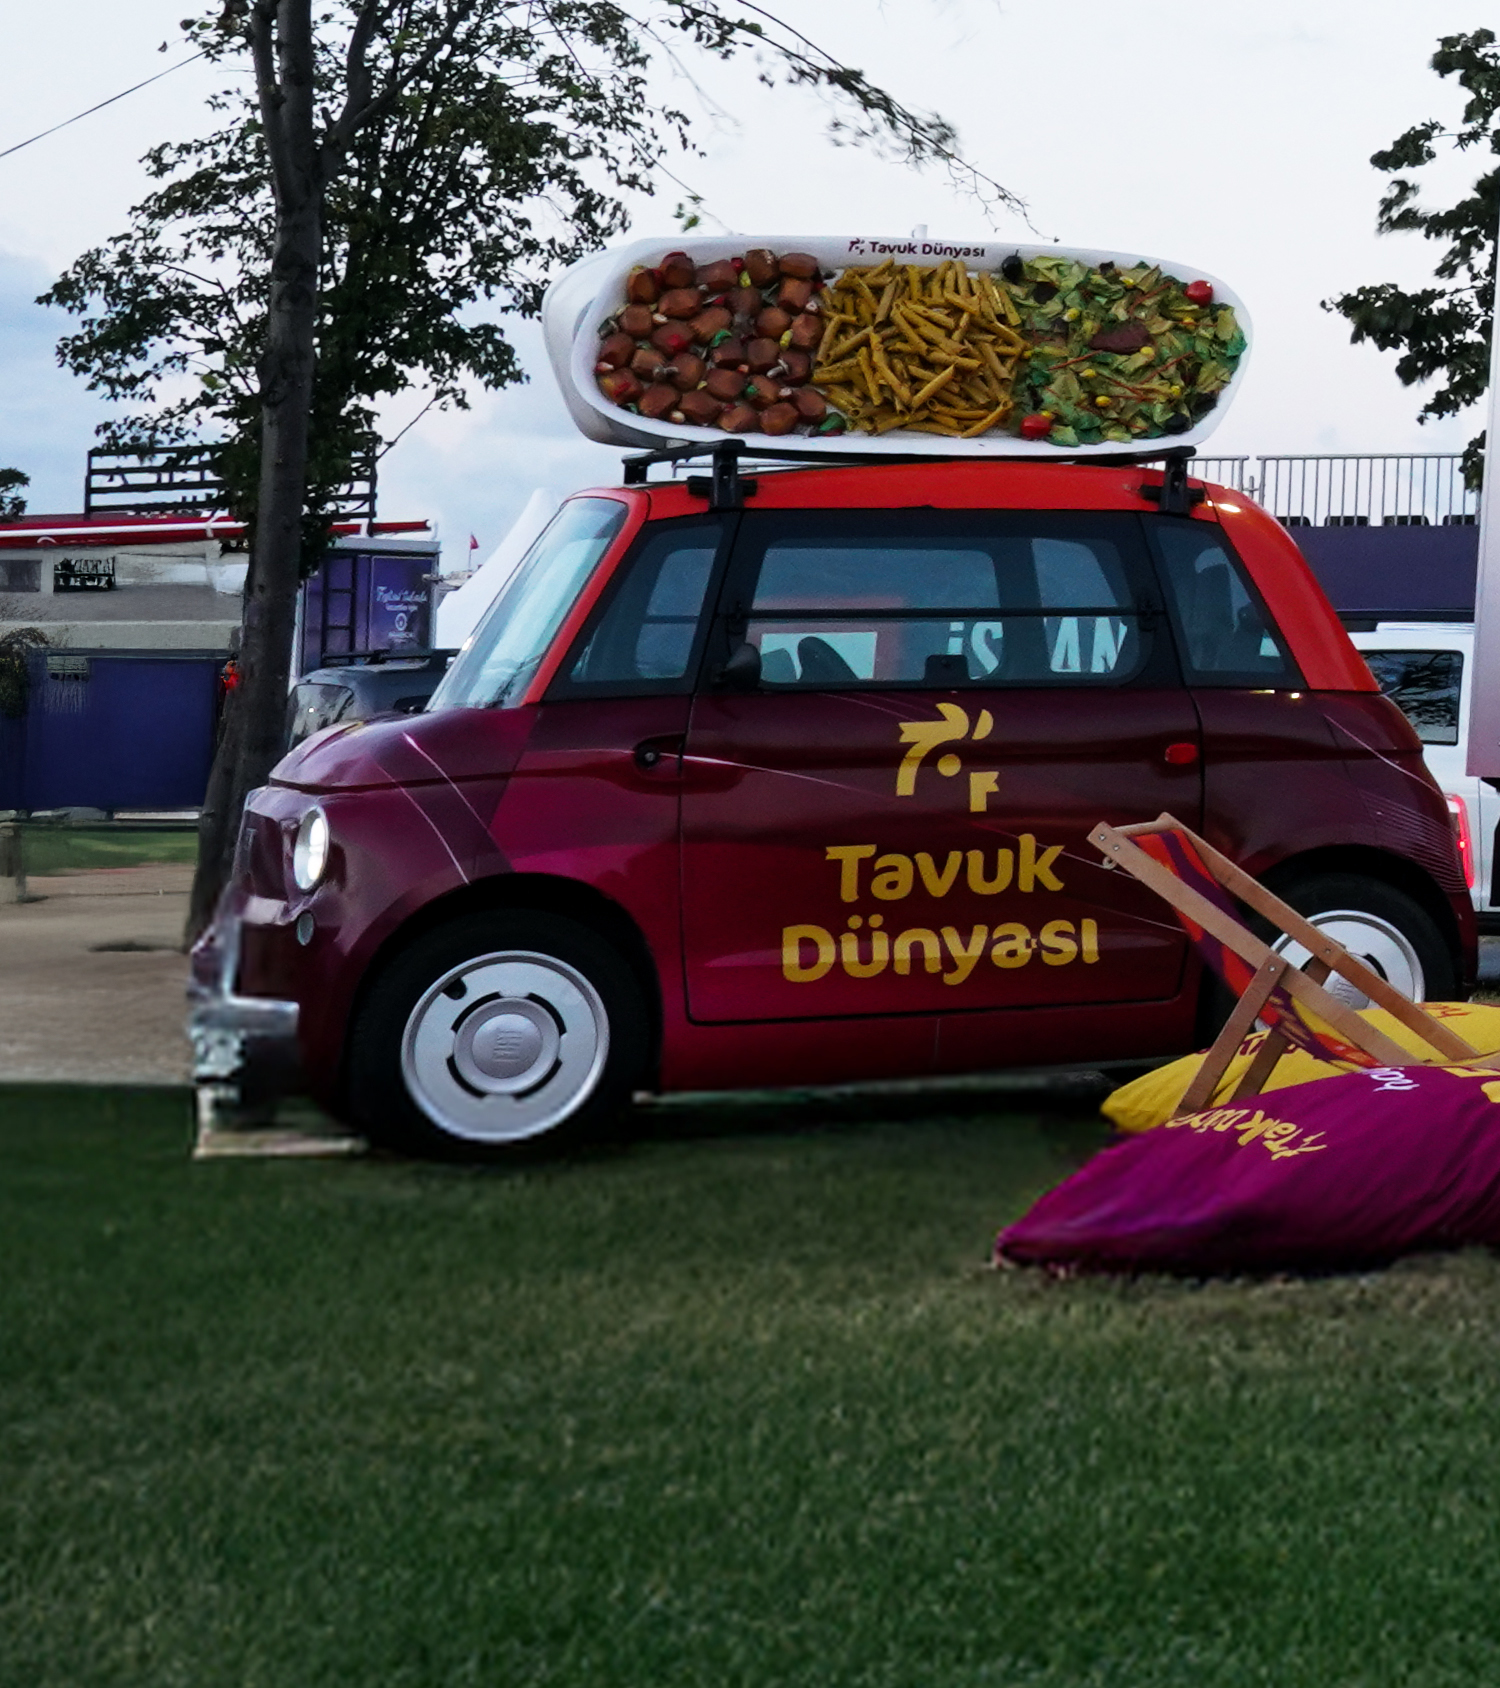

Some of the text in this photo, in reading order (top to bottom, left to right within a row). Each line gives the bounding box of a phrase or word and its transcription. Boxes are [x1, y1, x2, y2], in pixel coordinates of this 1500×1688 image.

[869, 241, 985, 259] Tavuk Dünyası
[825, 833, 1065, 903] Tavuk
[782, 914, 1100, 986] Dünyası
